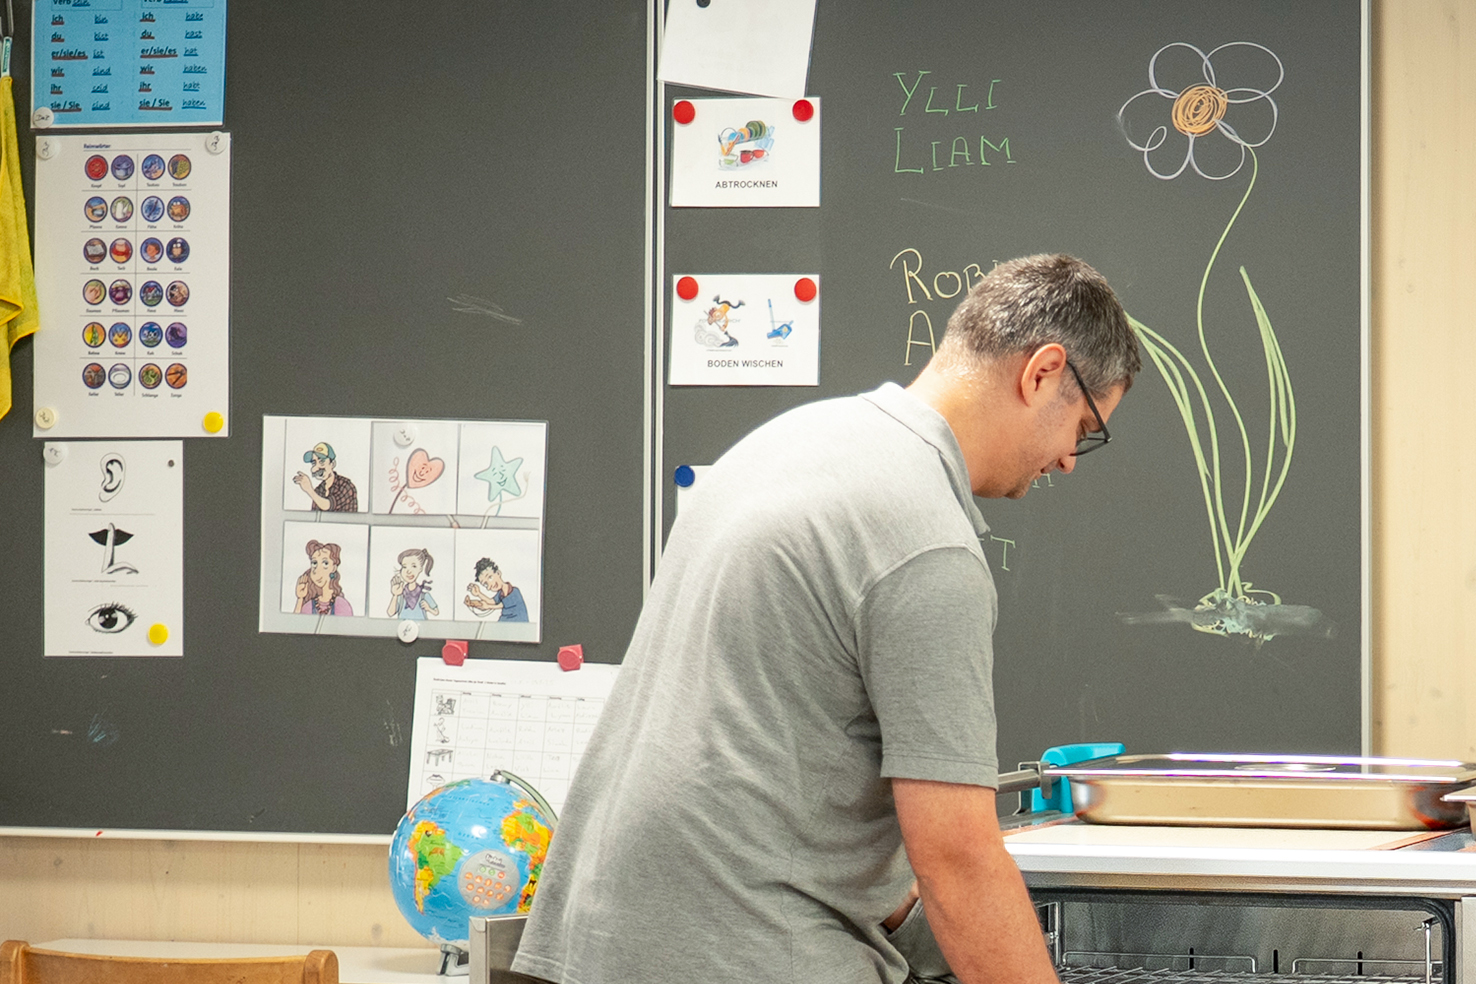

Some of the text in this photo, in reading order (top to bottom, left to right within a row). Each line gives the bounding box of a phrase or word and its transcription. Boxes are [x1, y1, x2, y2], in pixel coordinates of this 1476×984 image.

[52, 14, 64, 22] ich
[141, 29, 152, 37] du
[140, 46, 177, 55] er/sie/es
[51, 66, 64, 74] wir
[140, 64, 153, 72] wir
[51, 84, 61, 92] ihr
[894, 127, 1016, 174] LIAM
[715, 180, 778, 189] ABTROCKNEN
[707, 360, 784, 368] BODEN WISCHEN
